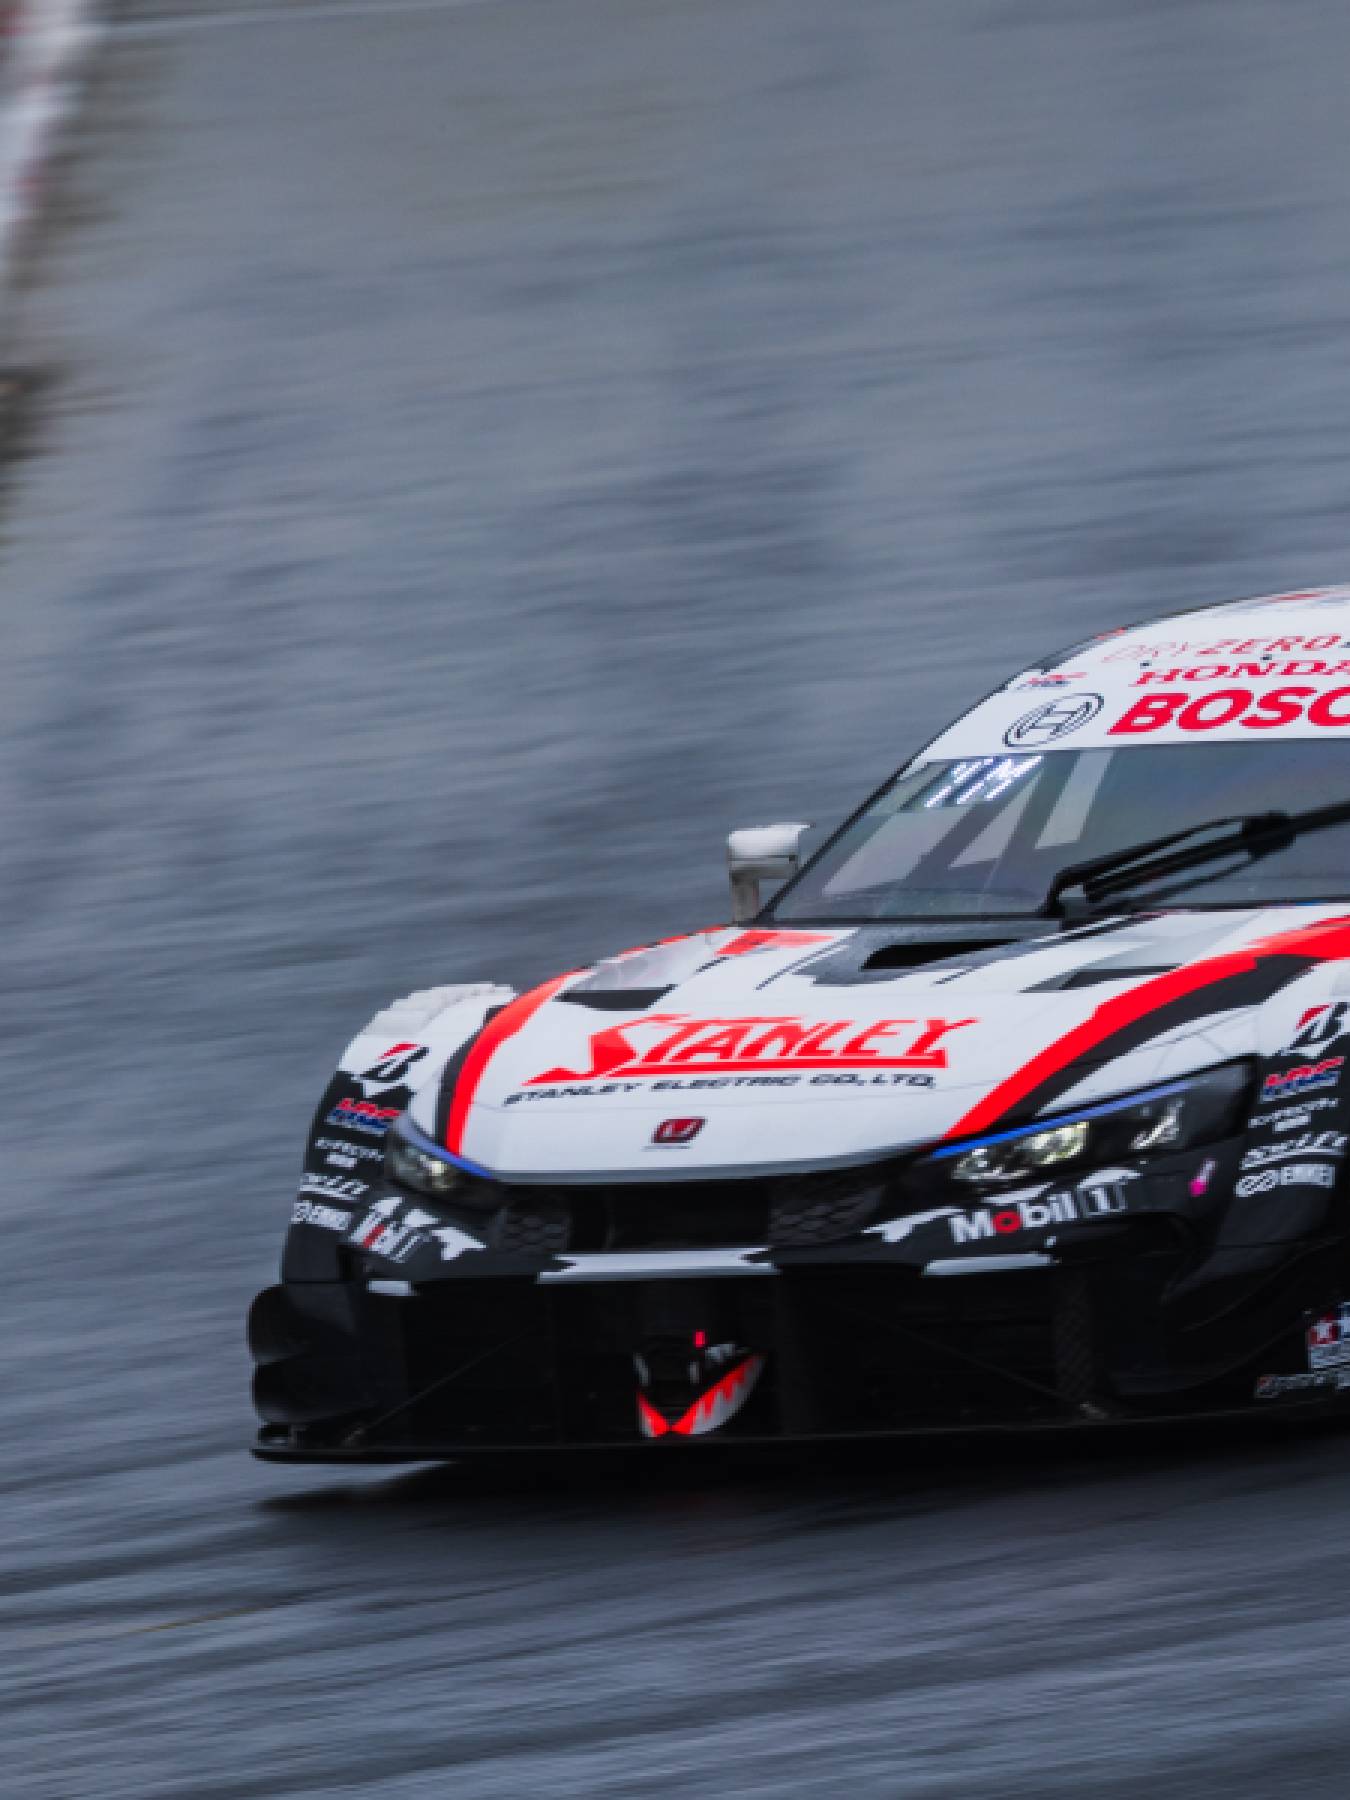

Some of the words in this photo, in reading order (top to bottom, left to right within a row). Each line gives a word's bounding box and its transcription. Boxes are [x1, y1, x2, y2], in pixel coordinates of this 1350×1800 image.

[522, 1013, 980, 1087] STANLEY
[503, 1083, 641, 1107] STANLEY
[948, 1191, 1077, 1244] Mobil
